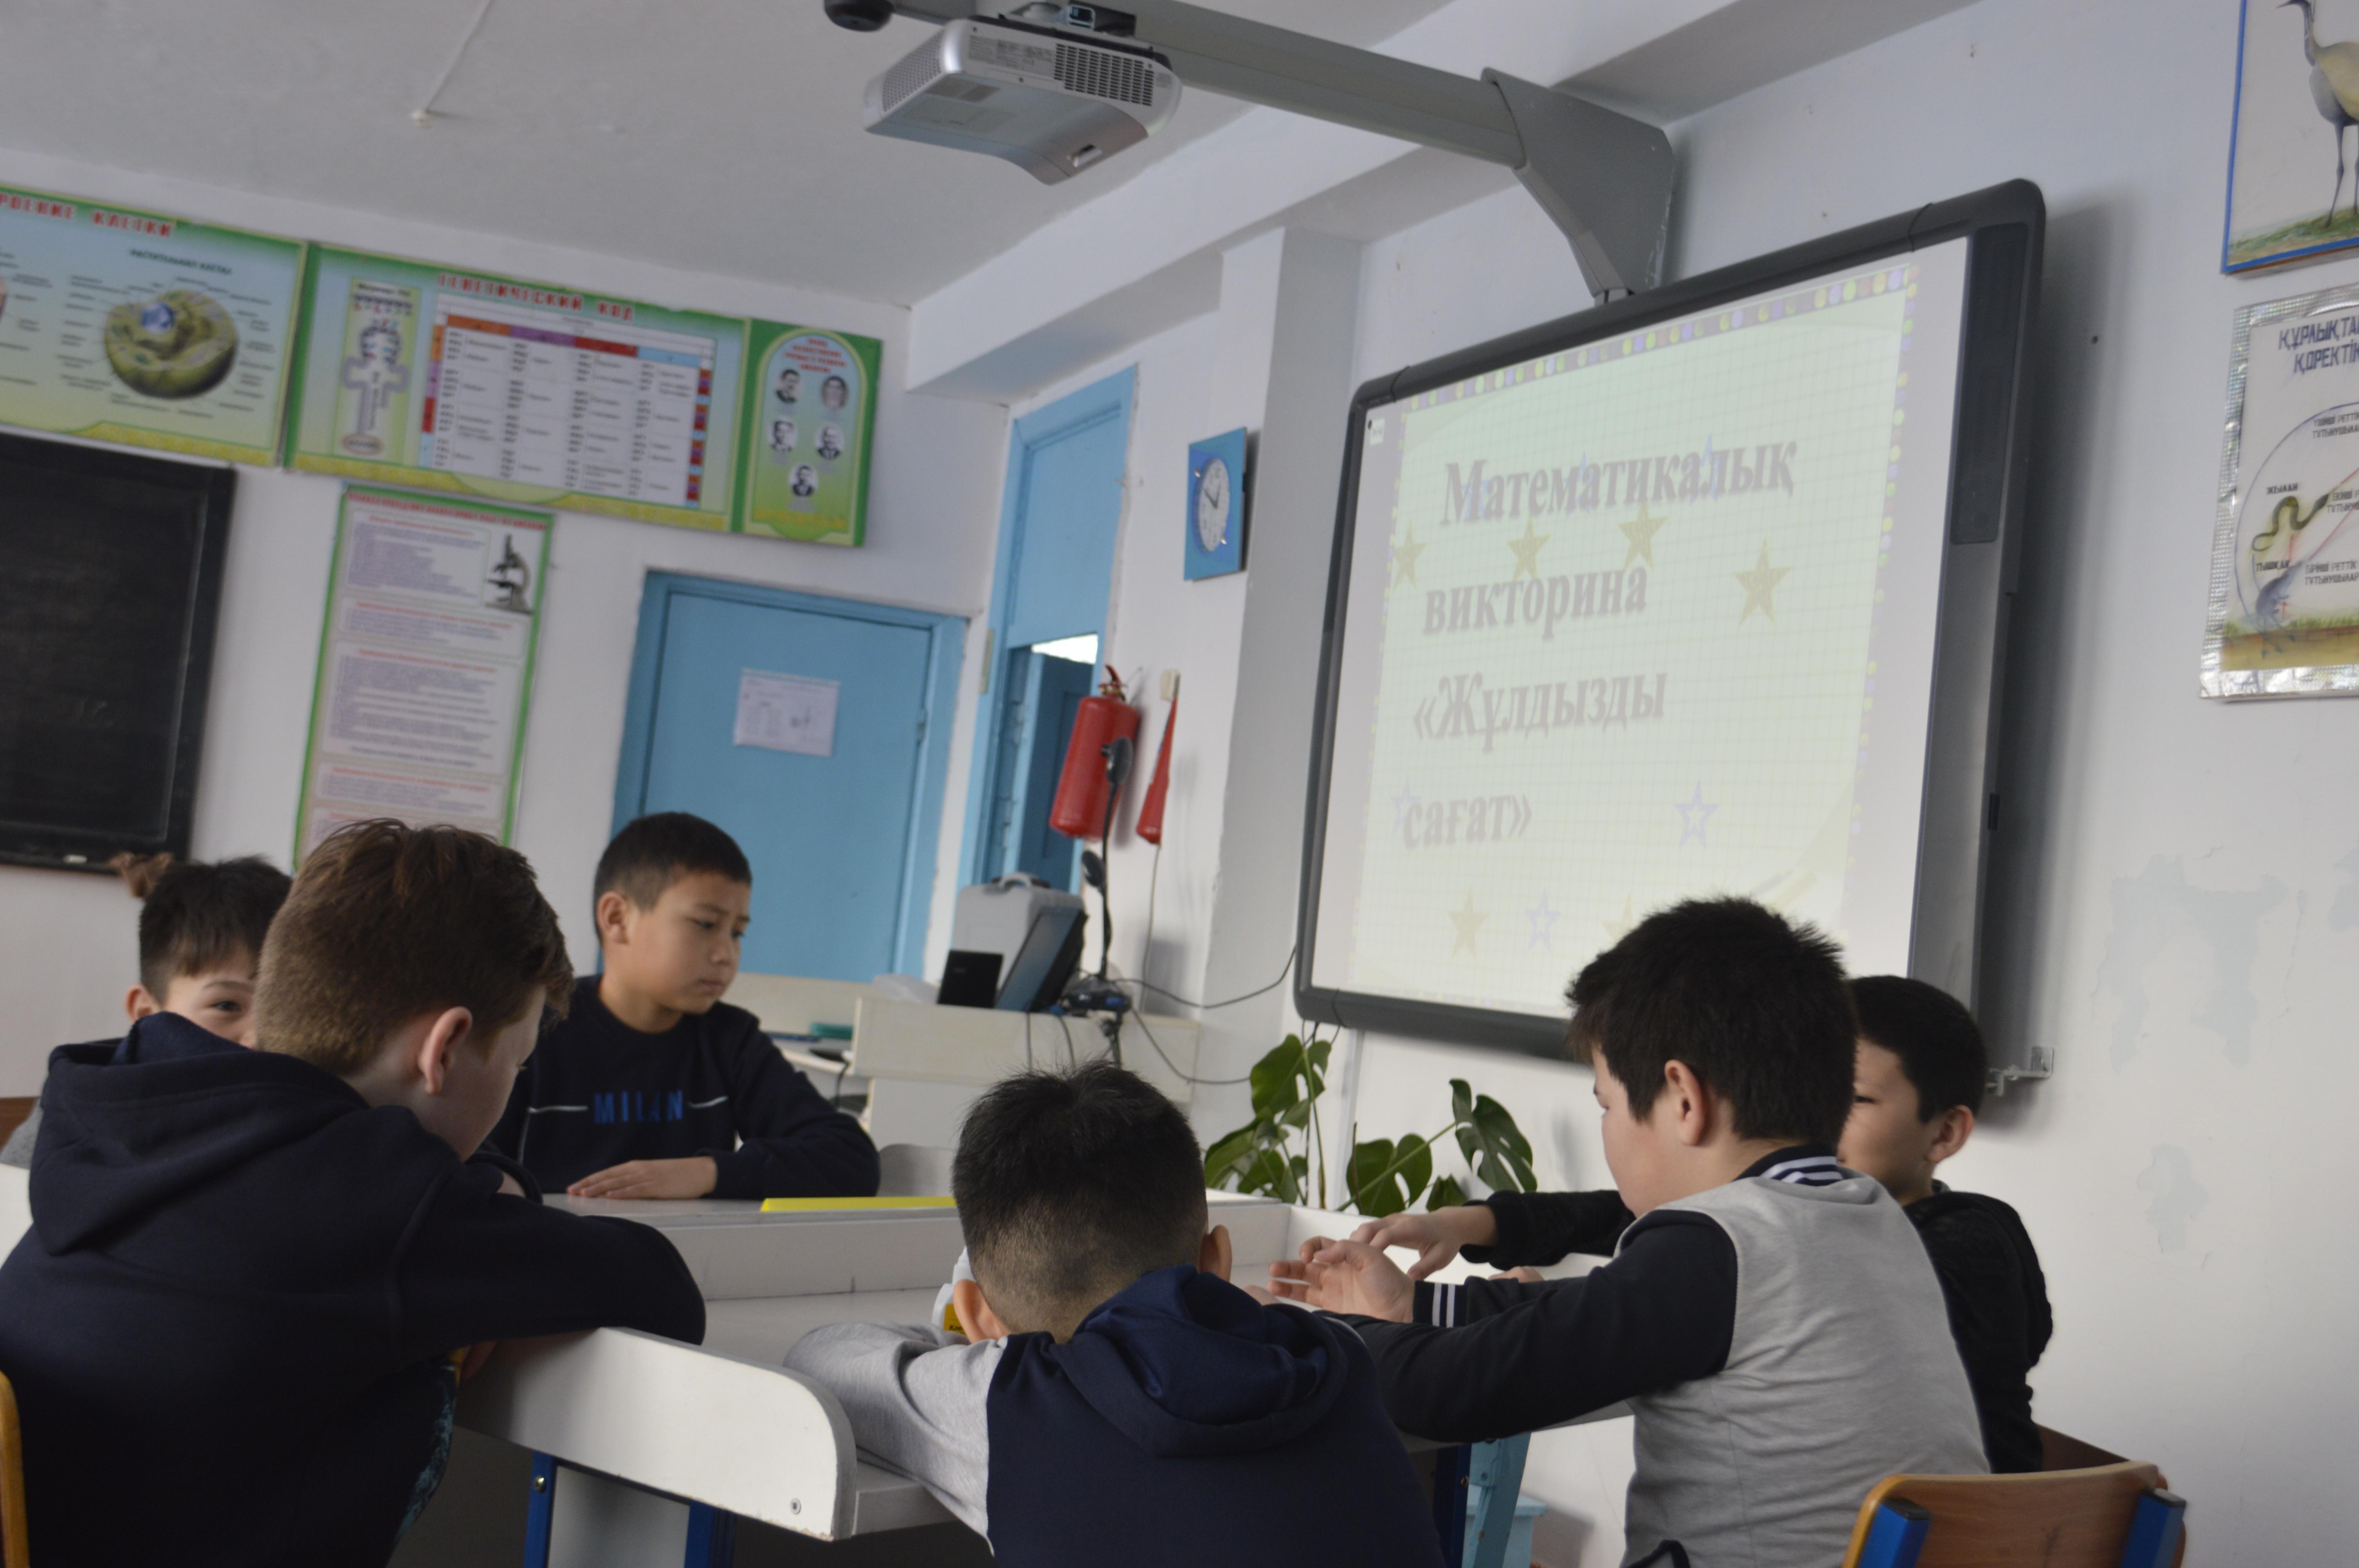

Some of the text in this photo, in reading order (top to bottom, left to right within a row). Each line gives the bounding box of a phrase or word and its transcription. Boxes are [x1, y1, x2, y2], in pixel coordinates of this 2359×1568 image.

[439, 273, 583, 310] ГЕНЕТИЧЕСКИЙ
[598, 301, 633, 321] КОД
[2278, 316, 2359, 350] ҚҰРЛЫҚТА
[1439, 441, 1797, 526] Математикалық
[1422, 566, 1647, 641] викторина
[1413, 671, 1668, 753] «Жұлдызды
[1403, 793, 1532, 849] сағат»
[594, 1090, 683, 1124] MILAN
